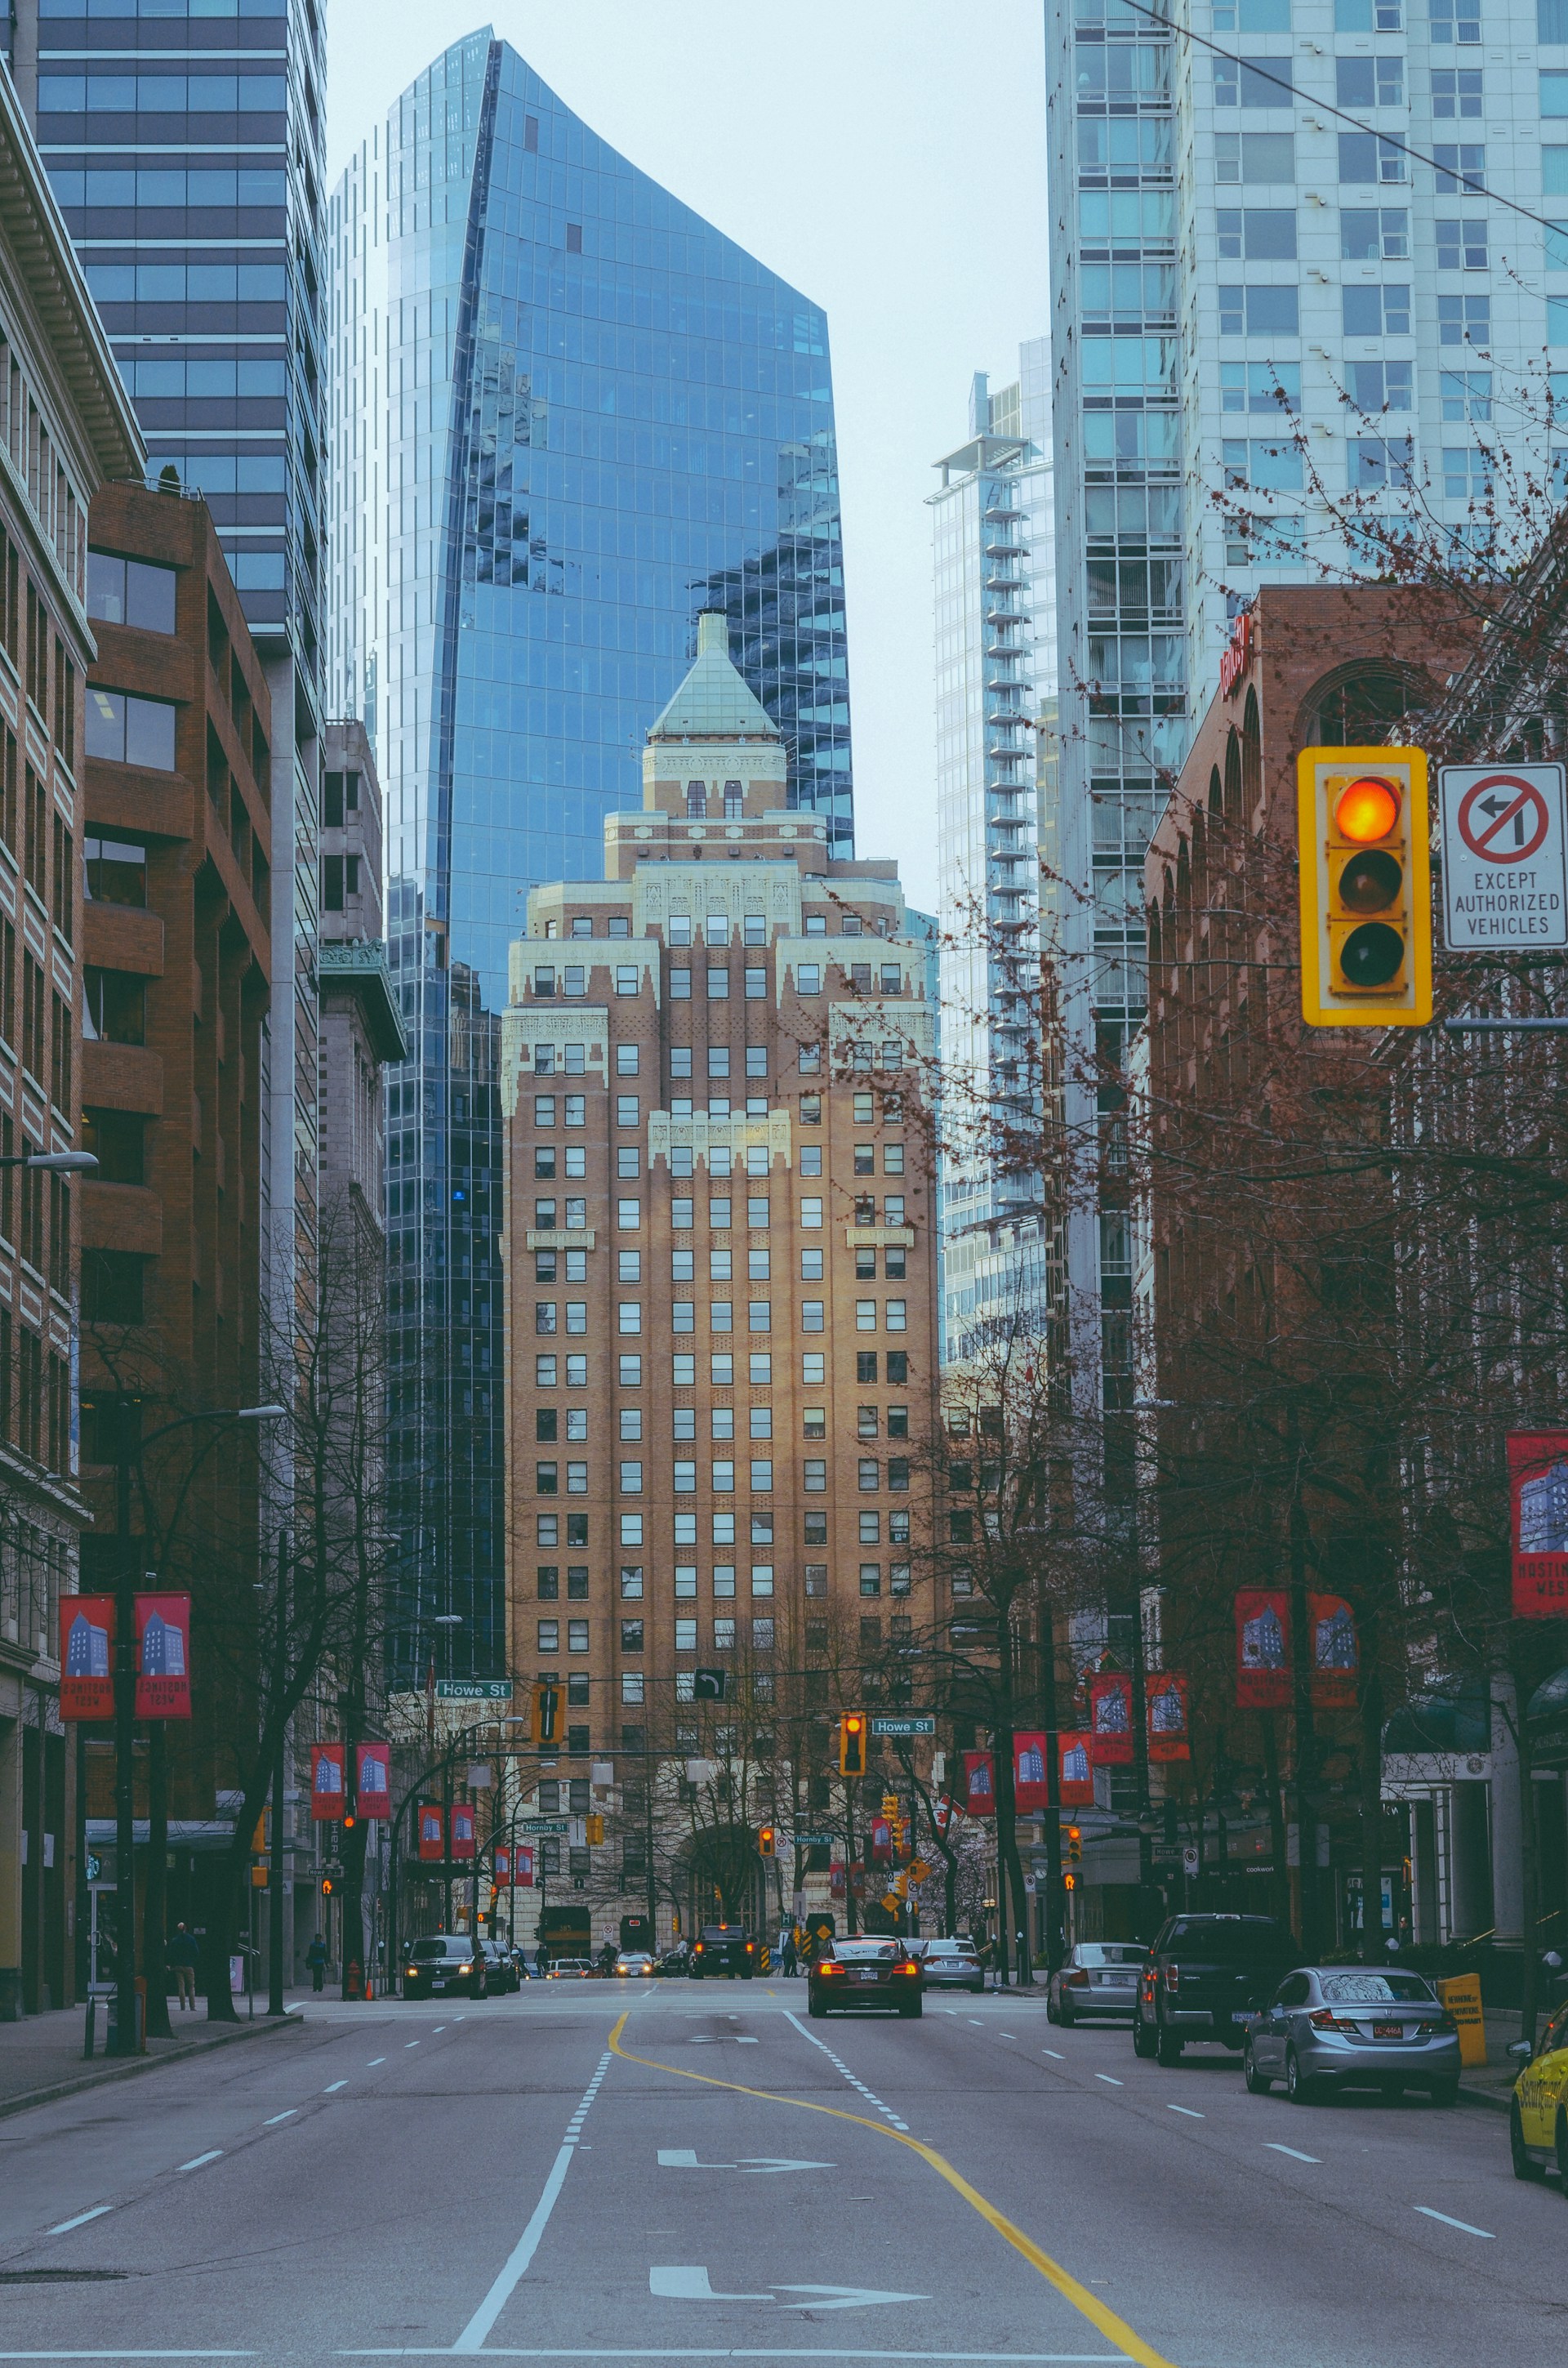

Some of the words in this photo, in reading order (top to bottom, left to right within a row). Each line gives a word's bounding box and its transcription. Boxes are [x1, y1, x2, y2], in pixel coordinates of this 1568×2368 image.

[1475, 872, 1537, 890] EXCEPT
[1455, 894, 1560, 912] AUTHORIZED
[1468, 917, 1549, 935] VEHICLES
[443, 1683, 483, 1697] Howe
[489, 1683, 506, 1697] St
[878, 1721, 911, 1732] Howe
[915, 1721, 929, 1732] St
[526, 1824, 553, 1832] Hornby
[782, 1914, 790, 1924] H
